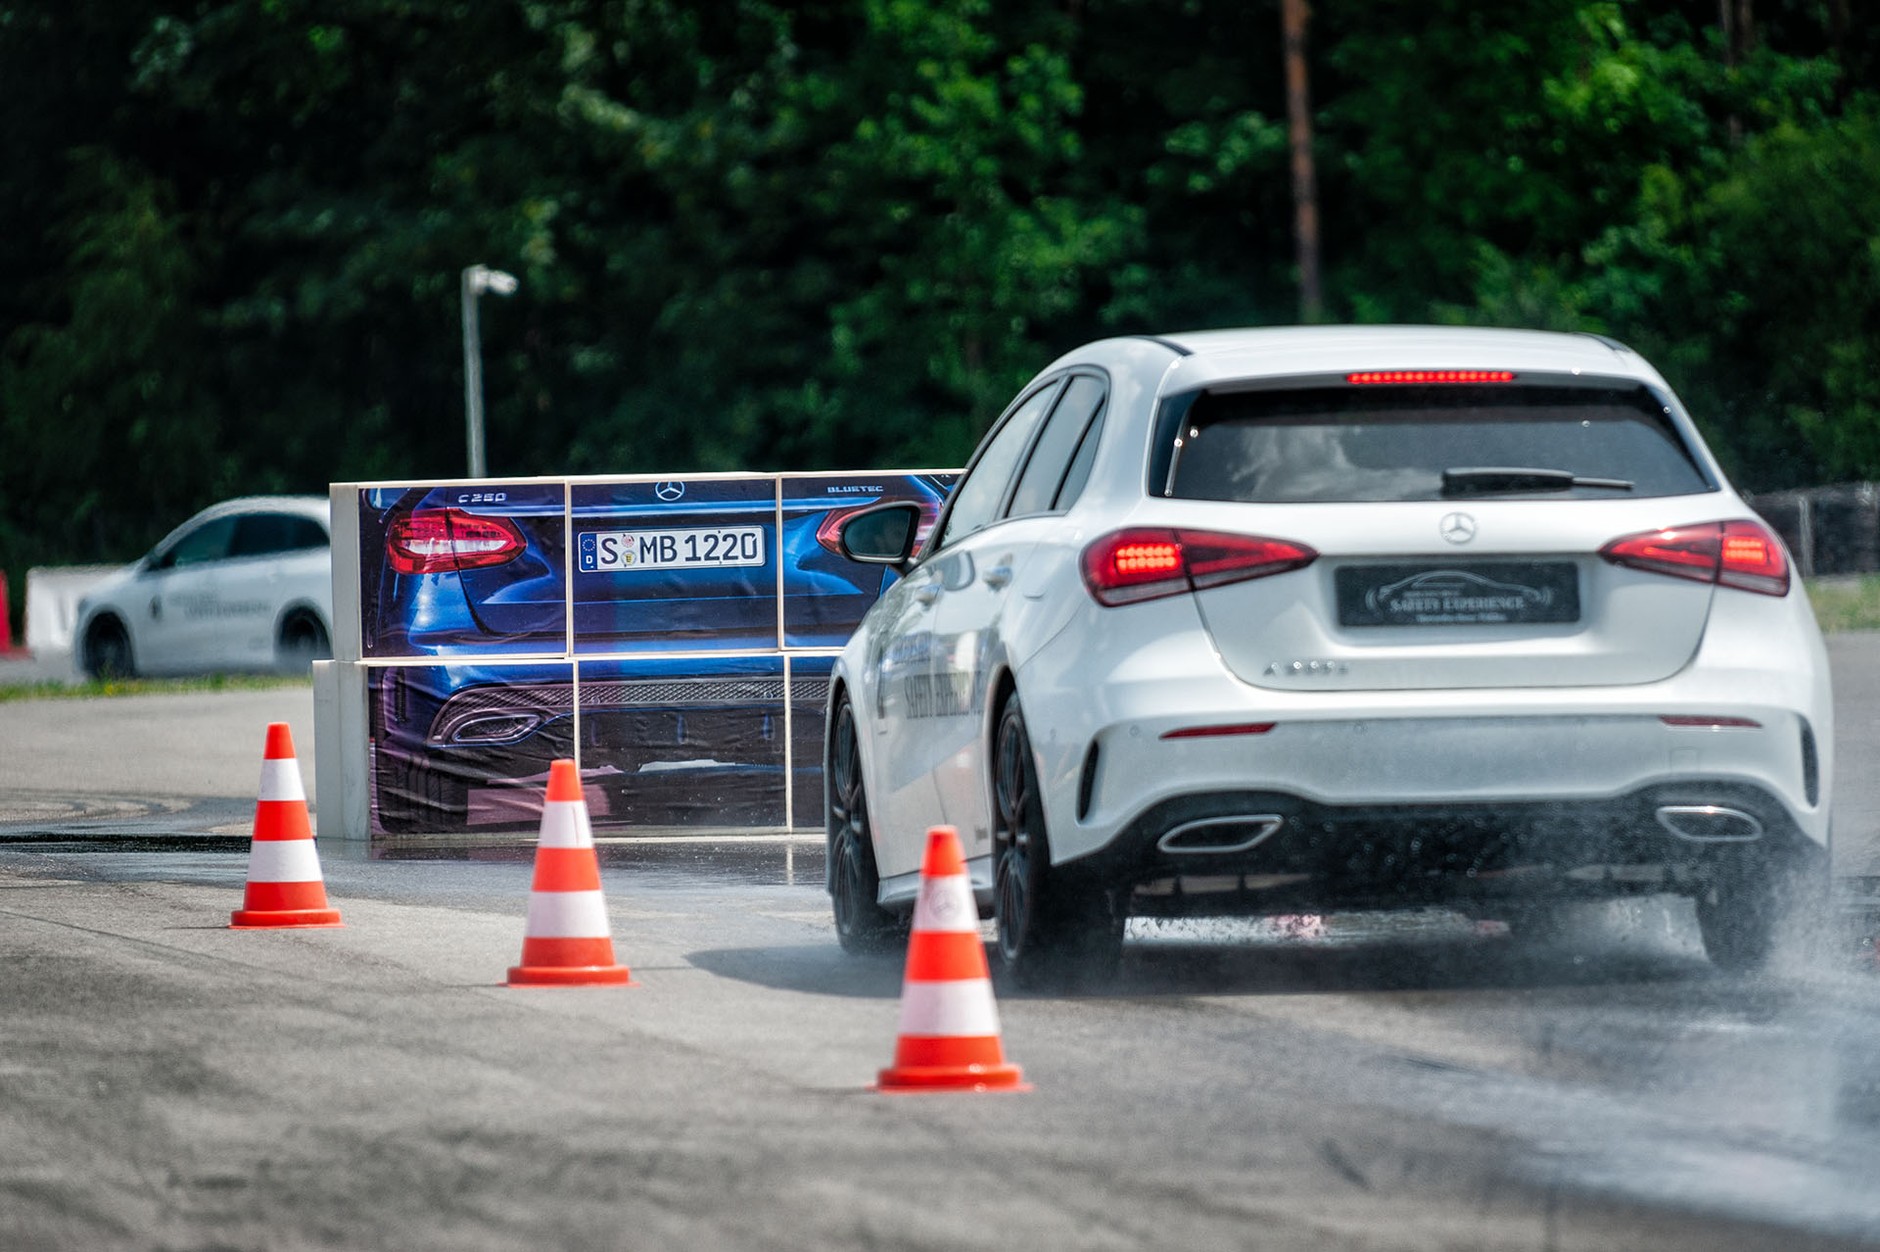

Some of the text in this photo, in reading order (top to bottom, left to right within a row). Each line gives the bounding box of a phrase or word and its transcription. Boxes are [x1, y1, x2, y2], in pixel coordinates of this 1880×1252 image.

[826, 485, 884, 494] BLUETEC
[600, 532, 758, 564] S MB 1220
[585, 555, 593, 564] D
